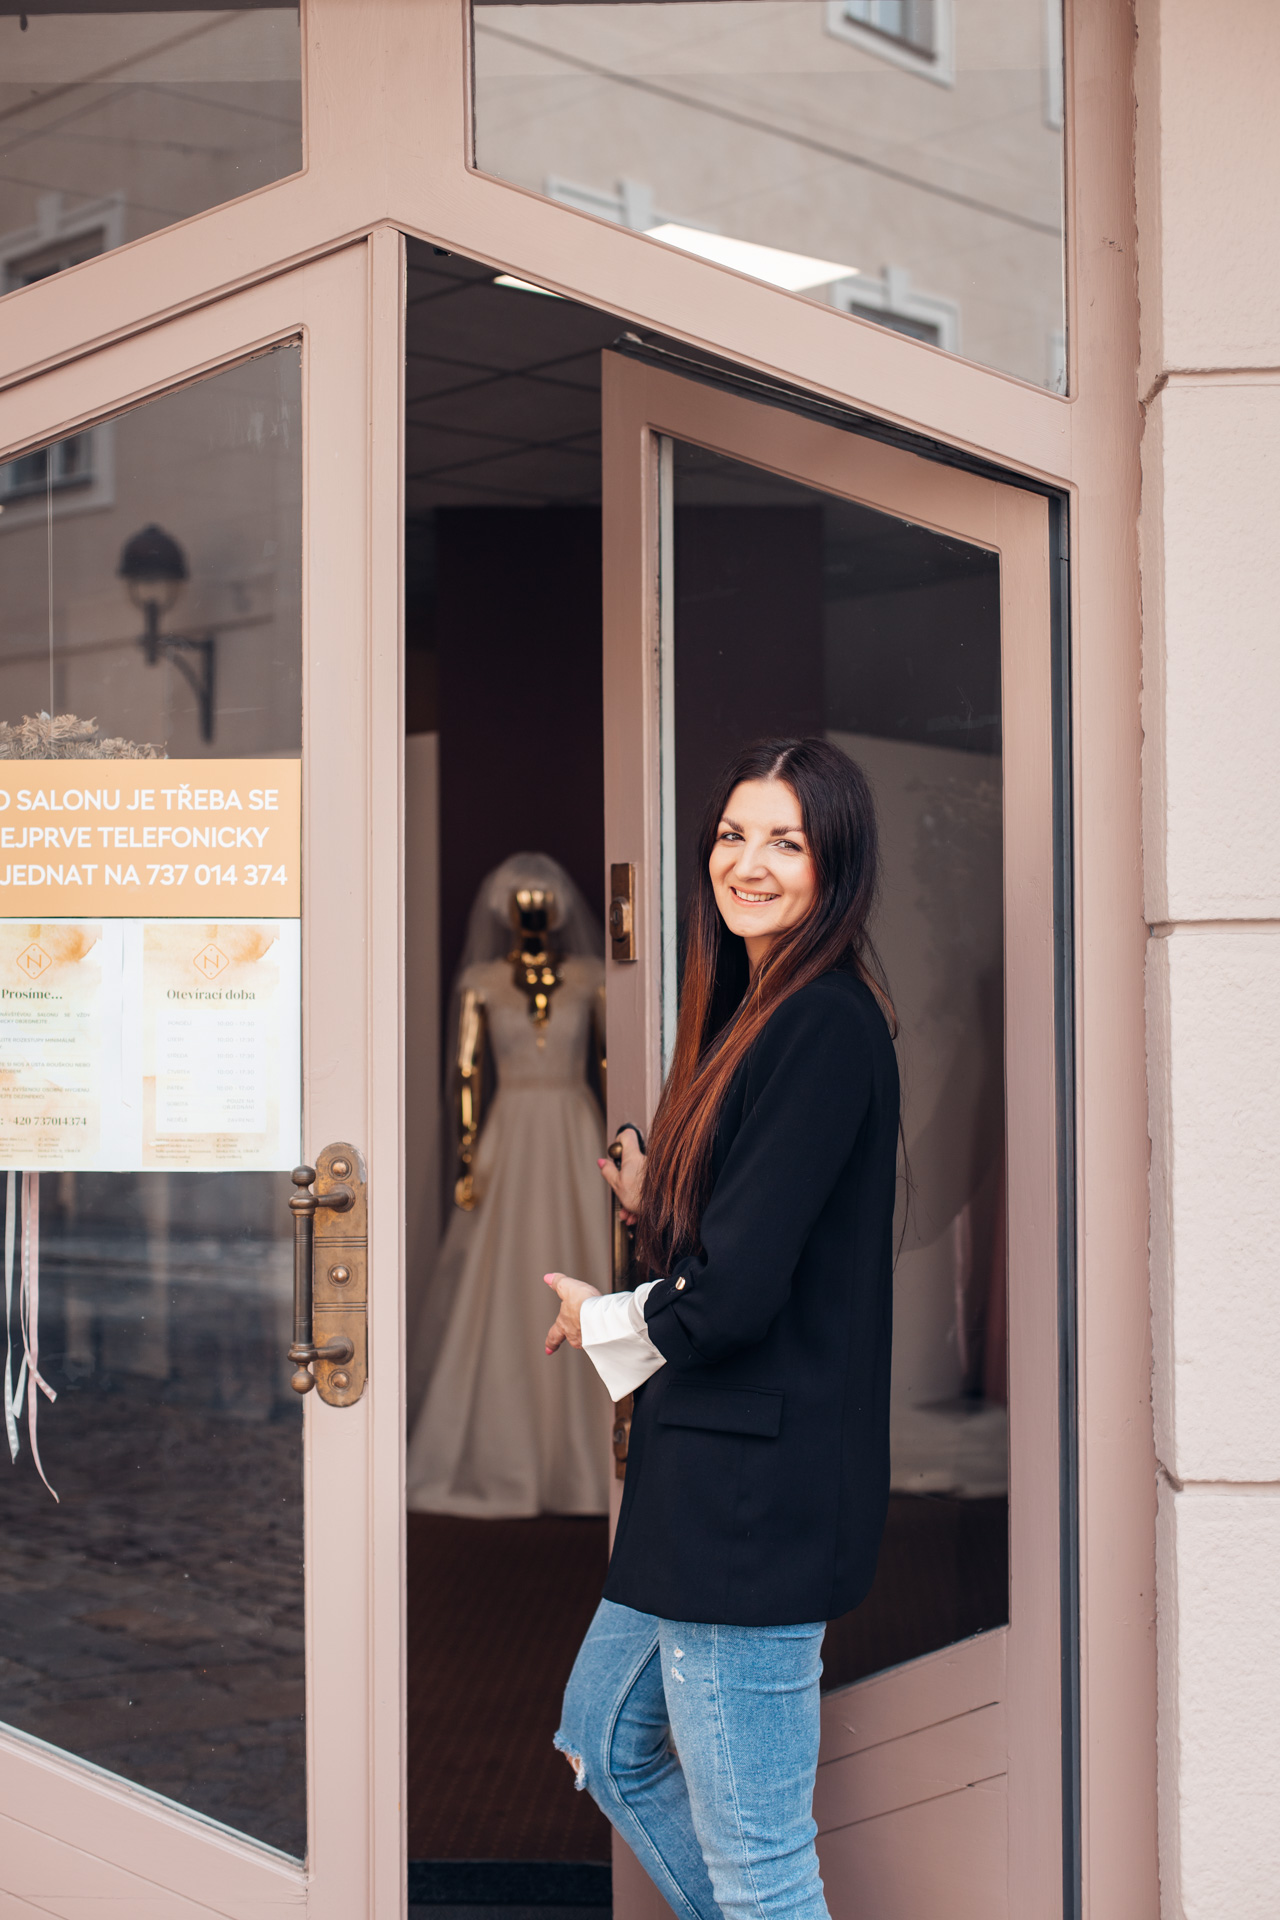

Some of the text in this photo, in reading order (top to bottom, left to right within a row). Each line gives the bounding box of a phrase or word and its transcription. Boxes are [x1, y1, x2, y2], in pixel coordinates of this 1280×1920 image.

[16, 789, 120, 811] SALONU
[126, 789, 155, 811] JE
[161, 784, 243, 811] TŘEBA
[248, 789, 279, 811] SE
[1, 826, 270, 849] EJPRVE TELEFONICKY
[0, 864, 288, 886] JEDNAT NA 737 014 374
[1, 987, 63, 1000] Prosíme...
[166, 988, 256, 1000] Otevírací doba
[33, 1116, 88, 1126] 737014374
